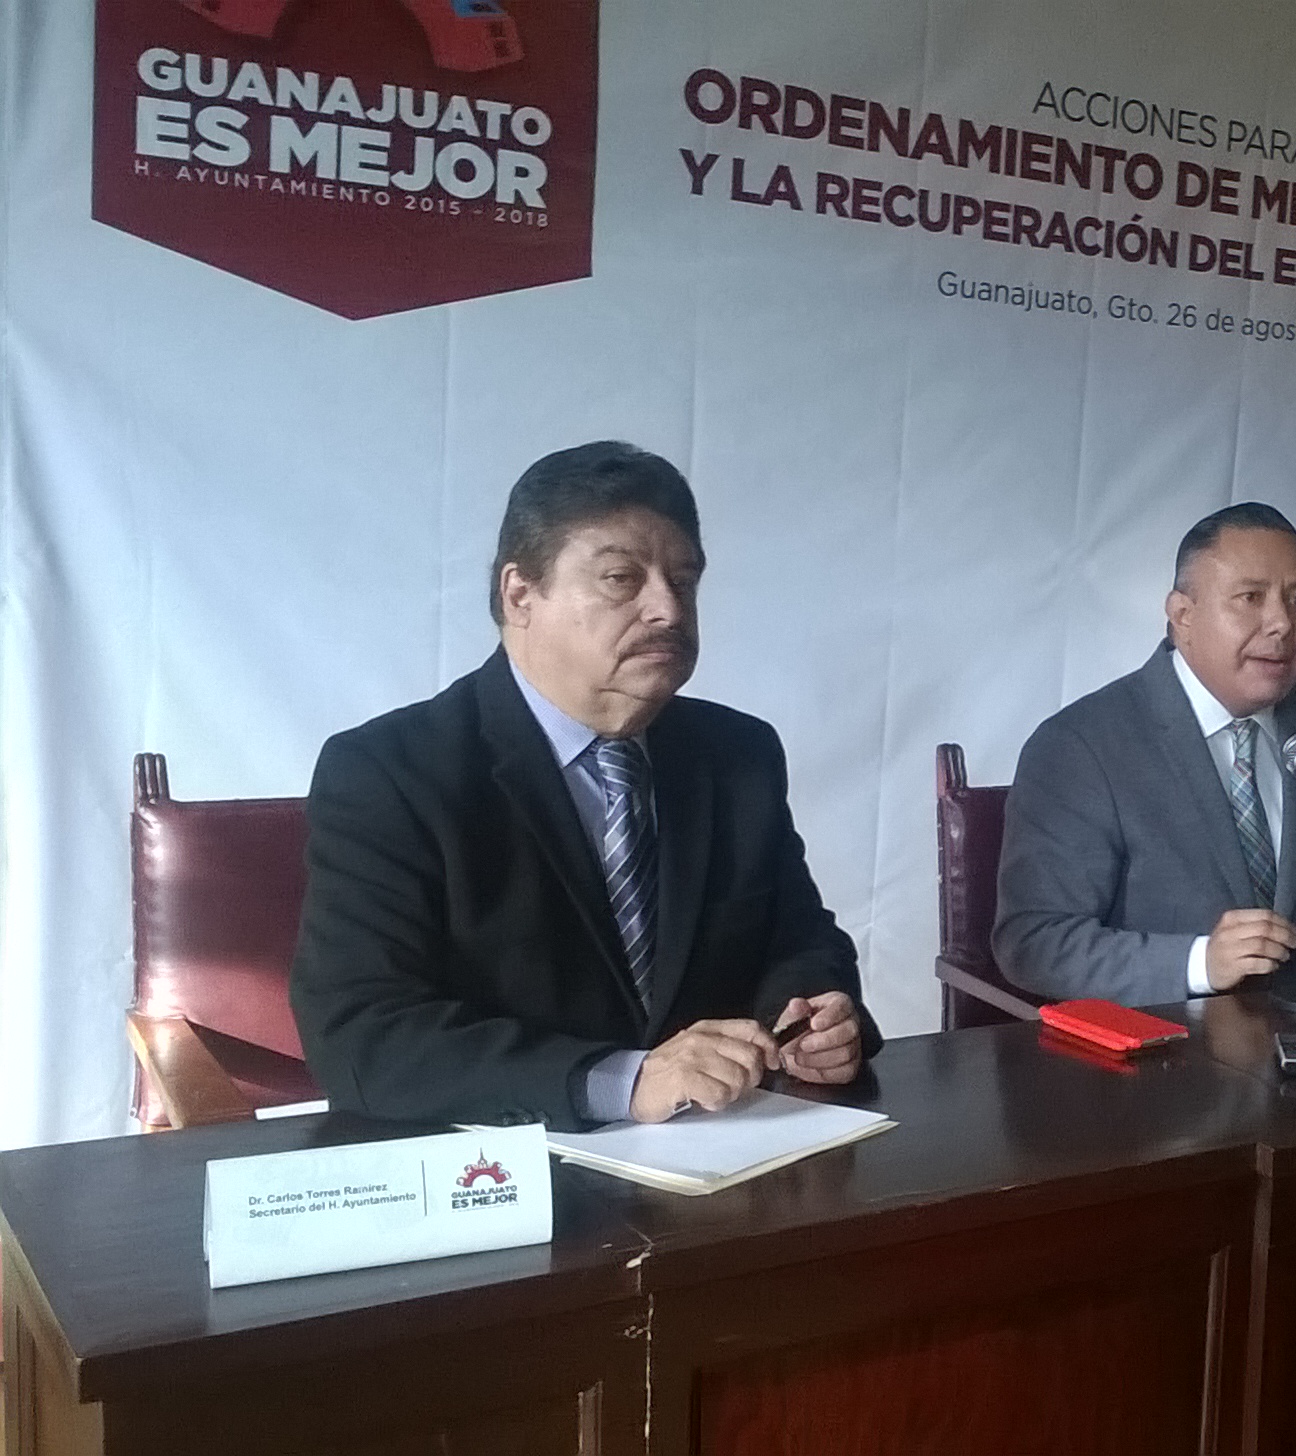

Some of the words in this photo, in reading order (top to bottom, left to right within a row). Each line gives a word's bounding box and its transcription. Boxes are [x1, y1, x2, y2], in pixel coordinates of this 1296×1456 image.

[137, 47, 551, 147] GUANAJUATO
[1032, 80, 1217, 148] ACCIONES
[135, 95, 250, 167] ES
[268, 116, 548, 209] MEJOR
[684, 67, 1164, 200] ORDENAMIENTO
[1176, 161, 1241, 216] DE
[134, 159, 161, 178] H.
[176, 166, 391, 207] AYUNTAMIENTO
[404, 195, 461, 216] 2015
[493, 206, 549, 229] 2018
[679, 148, 721, 196] Y
[730, 157, 803, 211] LA
[815, 171, 1179, 268] RECUPERACIÓN
[1188, 234, 1264, 281] DEL
[937, 270, 1098, 319] Guanajuato,
[1108, 294, 1159, 324] Gto.
[1165, 302, 1197, 329] 26
[1205, 307, 1235, 334] de
[248, 1196, 265, 1206] Dr.
[267, 1192, 304, 1204] Carlos
[306, 1187, 341, 1199] Torres
[249, 1205, 306, 1219] Secretario
[308, 1201, 326, 1213] del
[342, 1192, 417, 1209] Ayuntamiento
[451, 1185, 518, 1199] GUANAJUATO
[451, 1198, 469, 1209] ES
[471, 1193, 518, 1207] MEJOR
